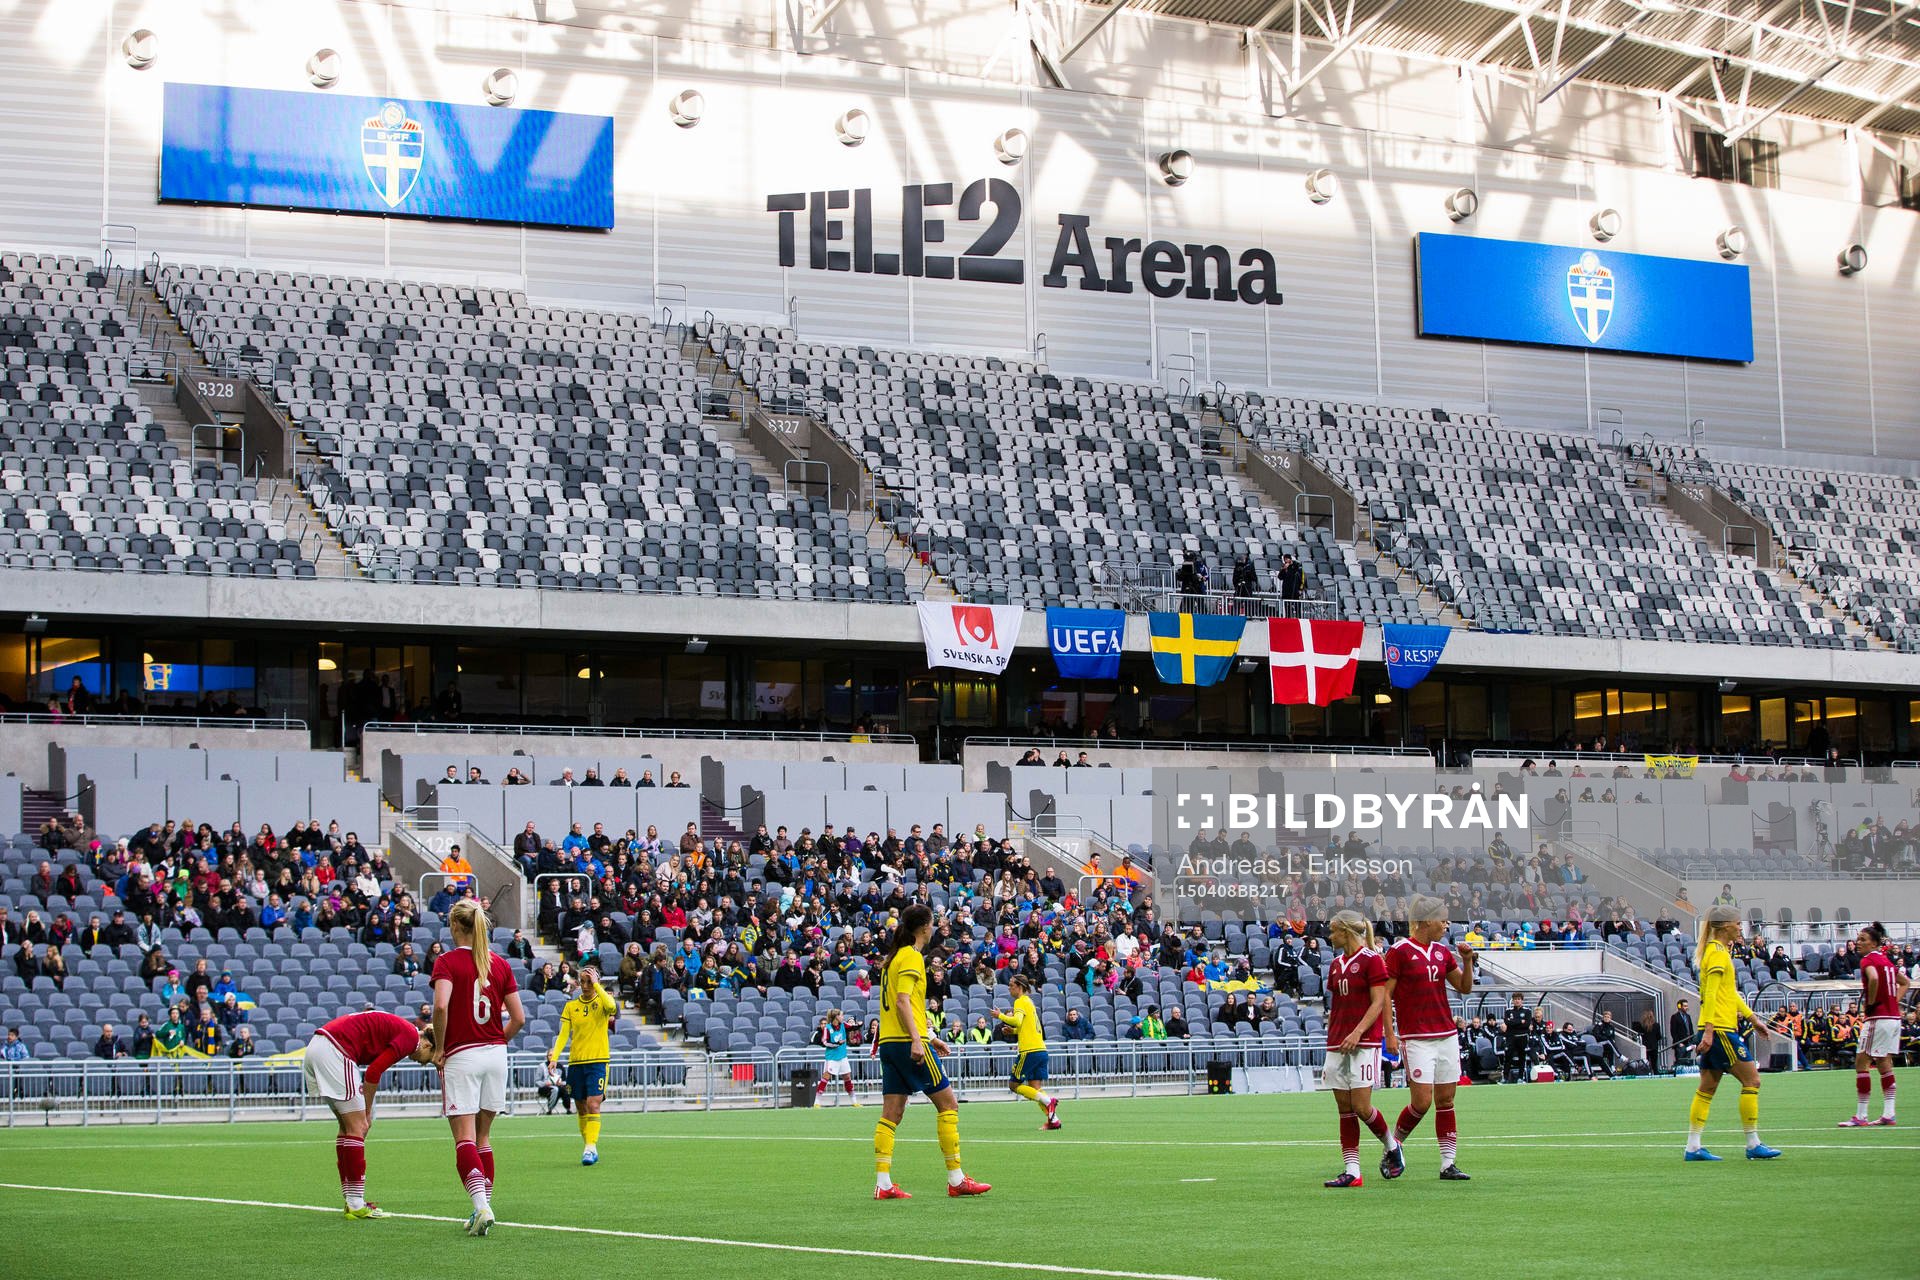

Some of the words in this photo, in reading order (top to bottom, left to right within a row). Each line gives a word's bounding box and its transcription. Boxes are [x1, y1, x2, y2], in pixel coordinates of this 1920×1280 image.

[767, 178, 1024, 284] TELE2
[1043, 213, 1283, 305] Arena
[198, 381, 234, 398] B328
[1053, 627, 1122, 654] UEFA
[943, 648, 993, 665] SVENSKA
[995, 655, 1008, 667] SP
[1426, 965, 1439, 983] 12
[1884, 965, 1897, 997] 11
[1338, 978, 1349, 997] 10
[473, 978, 491, 1025] 6
[583, 1005, 589, 1017] 9
[1360, 1063, 1373, 1081] 10
[597, 1077, 605, 1091] 9
